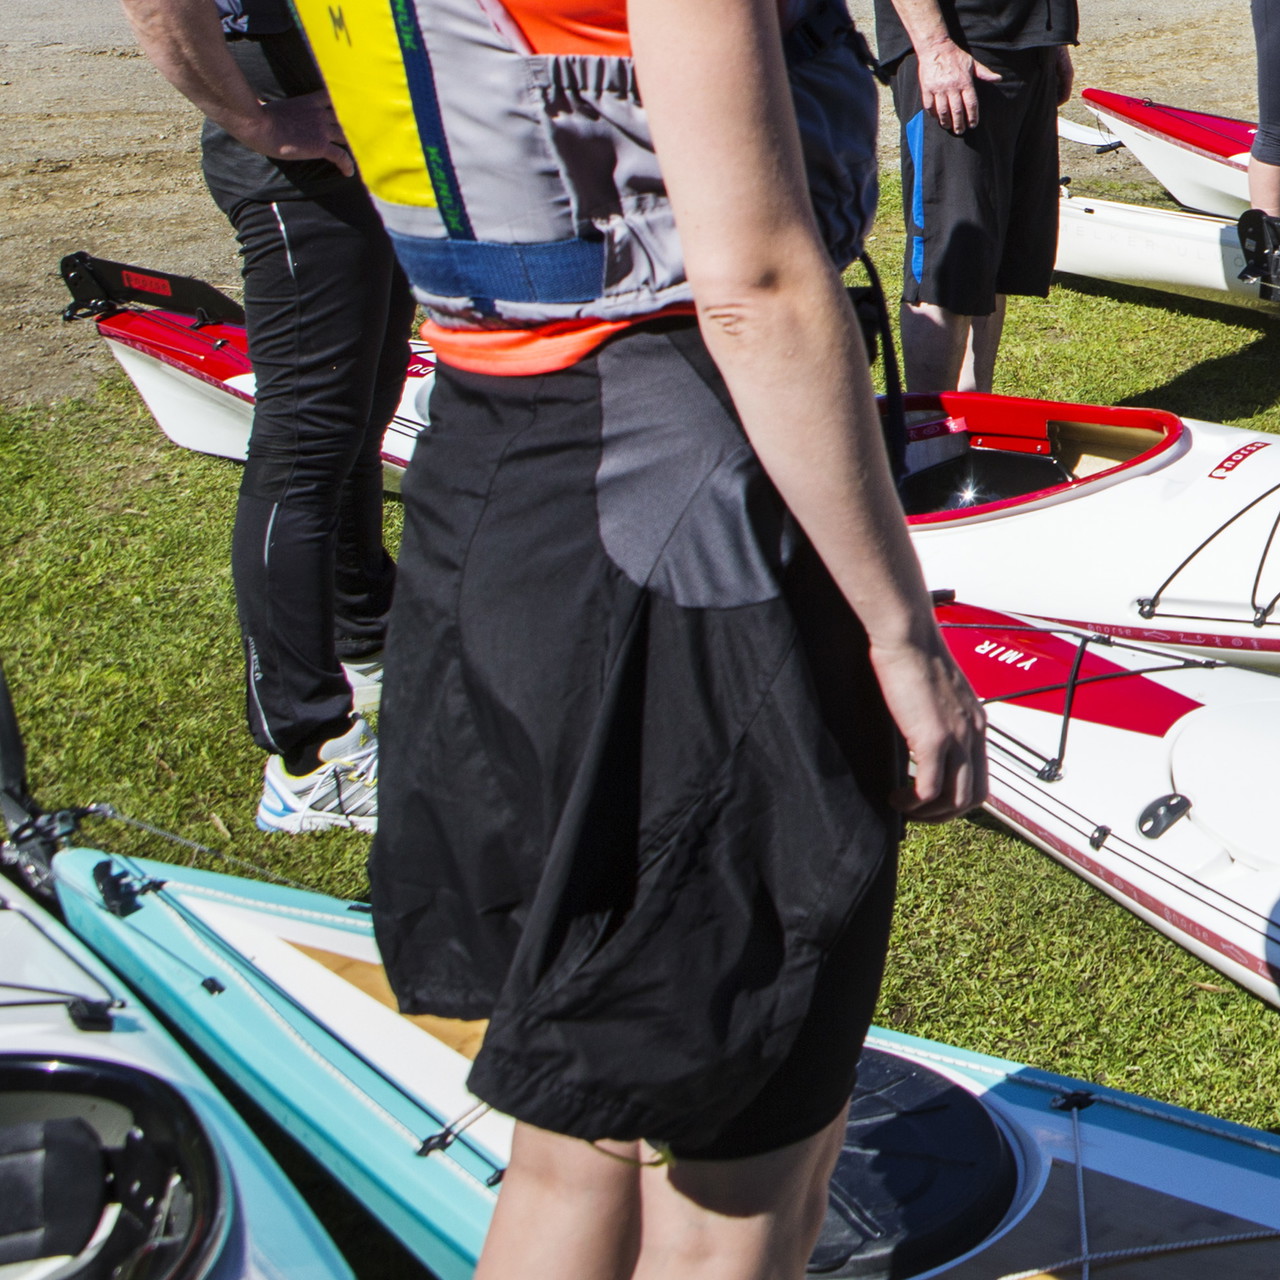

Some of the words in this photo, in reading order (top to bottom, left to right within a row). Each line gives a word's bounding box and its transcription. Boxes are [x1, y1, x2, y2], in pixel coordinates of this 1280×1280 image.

[327, 5, 352, 48] M
[425, 145, 464, 232] KANUK
[1222, 442, 1266, 469] norse
[974, 638, 1040, 672] YMIR
